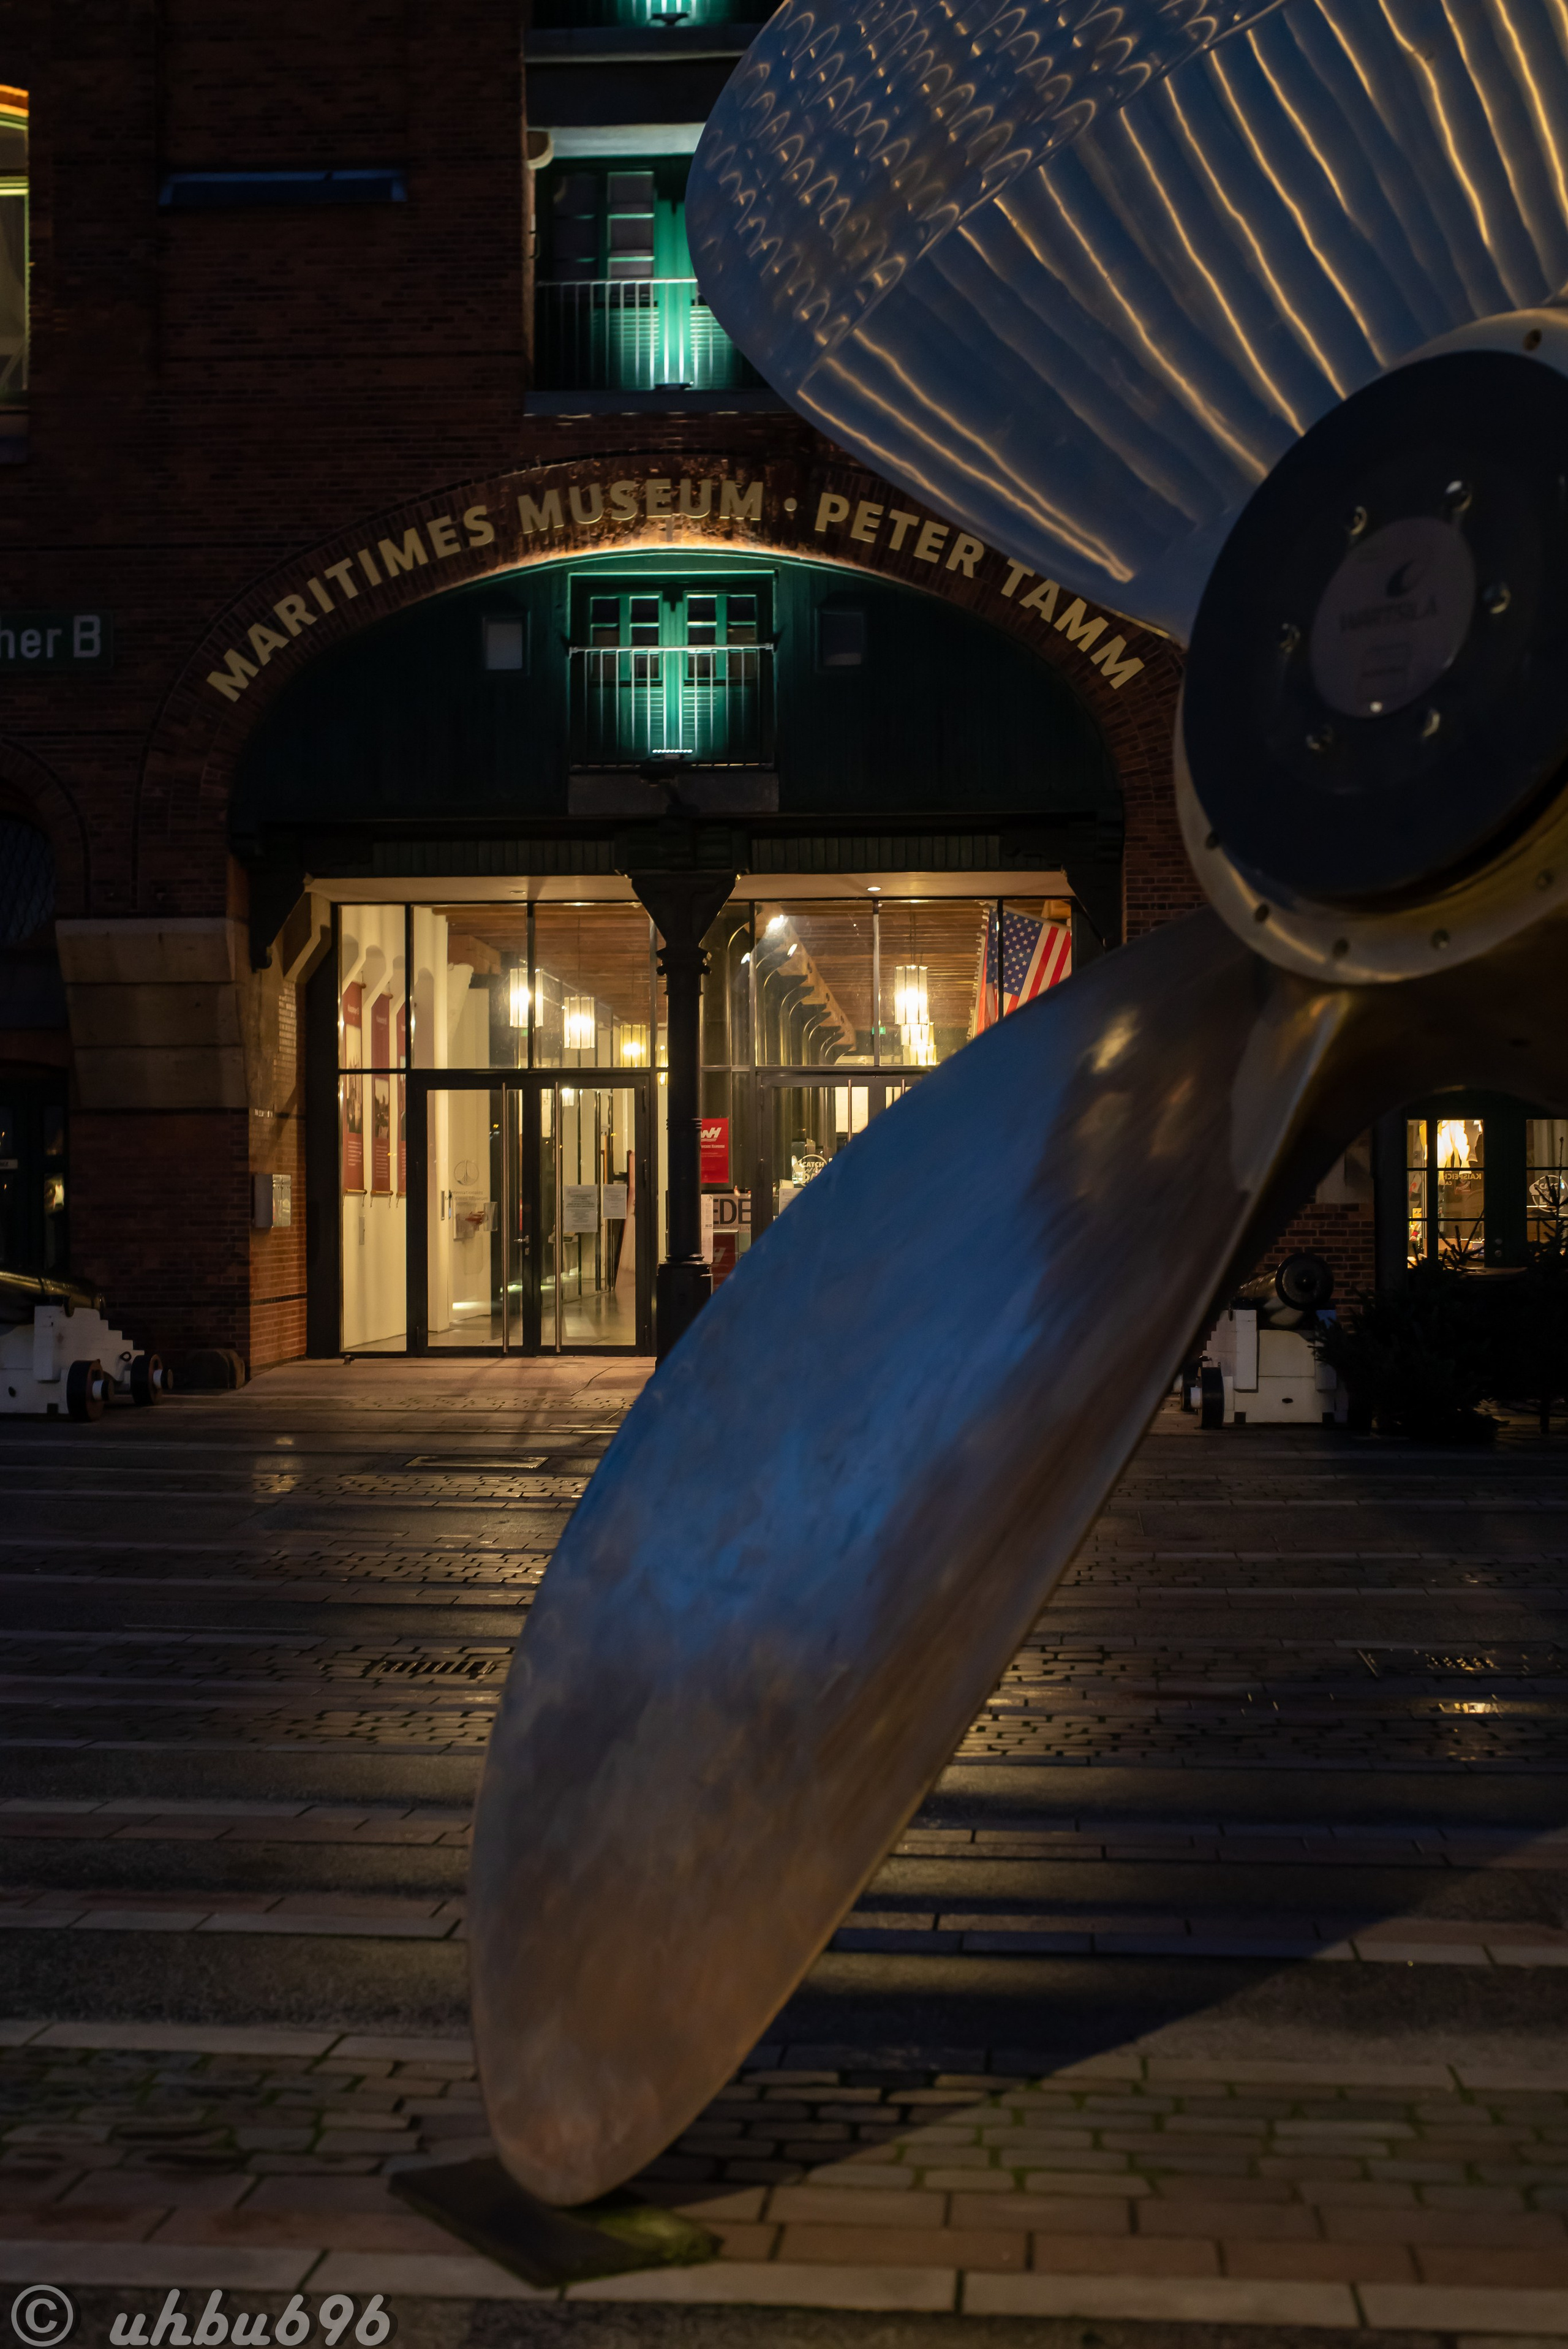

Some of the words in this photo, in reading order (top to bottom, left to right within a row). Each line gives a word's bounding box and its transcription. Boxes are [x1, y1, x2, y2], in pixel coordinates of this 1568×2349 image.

[73, 614, 101, 658] B
[206, 505, 495, 703] MARITIMES
[517, 478, 764, 536] MUSEUM
[814, 492, 986, 578] PETER
[1001, 556, 1146, 690] TAMM
